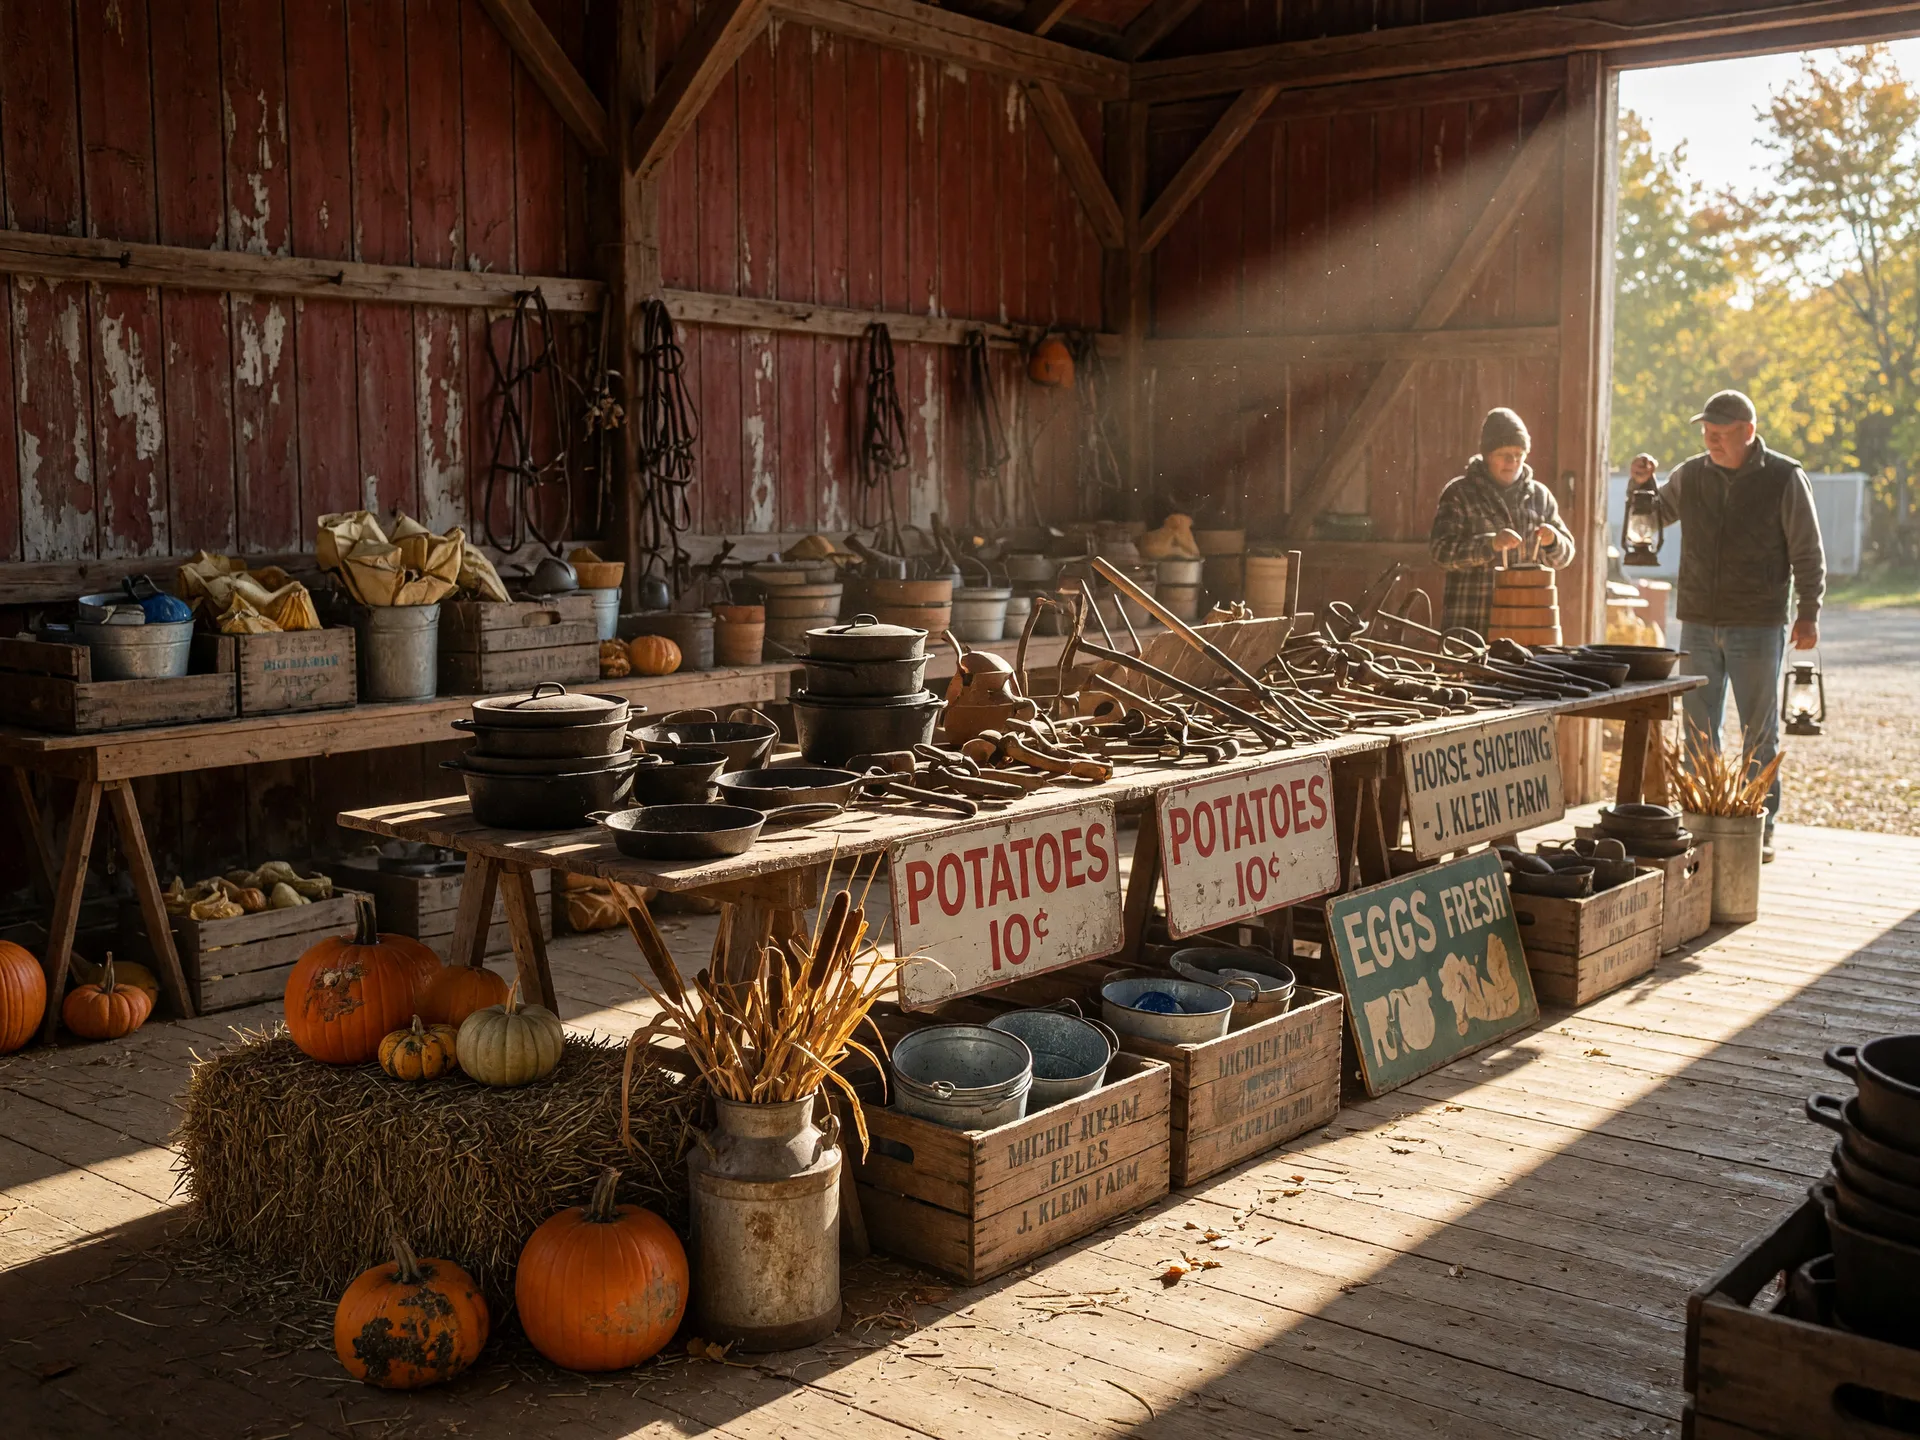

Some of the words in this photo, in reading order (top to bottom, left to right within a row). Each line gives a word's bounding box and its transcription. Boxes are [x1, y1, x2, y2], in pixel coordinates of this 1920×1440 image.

[1411, 742, 1471, 793] HORSE
[1168, 774, 1328, 866] POTATOES
[1450, 787, 1502, 836] KLEIN
[1505, 774, 1550, 820] FARM
[905, 822, 1109, 926] POTATOES
[1235, 851, 1280, 907] 10¢
[989, 907, 1050, 971] 10¢
[1342, 889, 1437, 979] EGGS
[1439, 872, 1507, 939] FRESH
[1038, 1183, 1089, 1226] KLEIN
[1095, 1160, 1140, 1201] FARM
